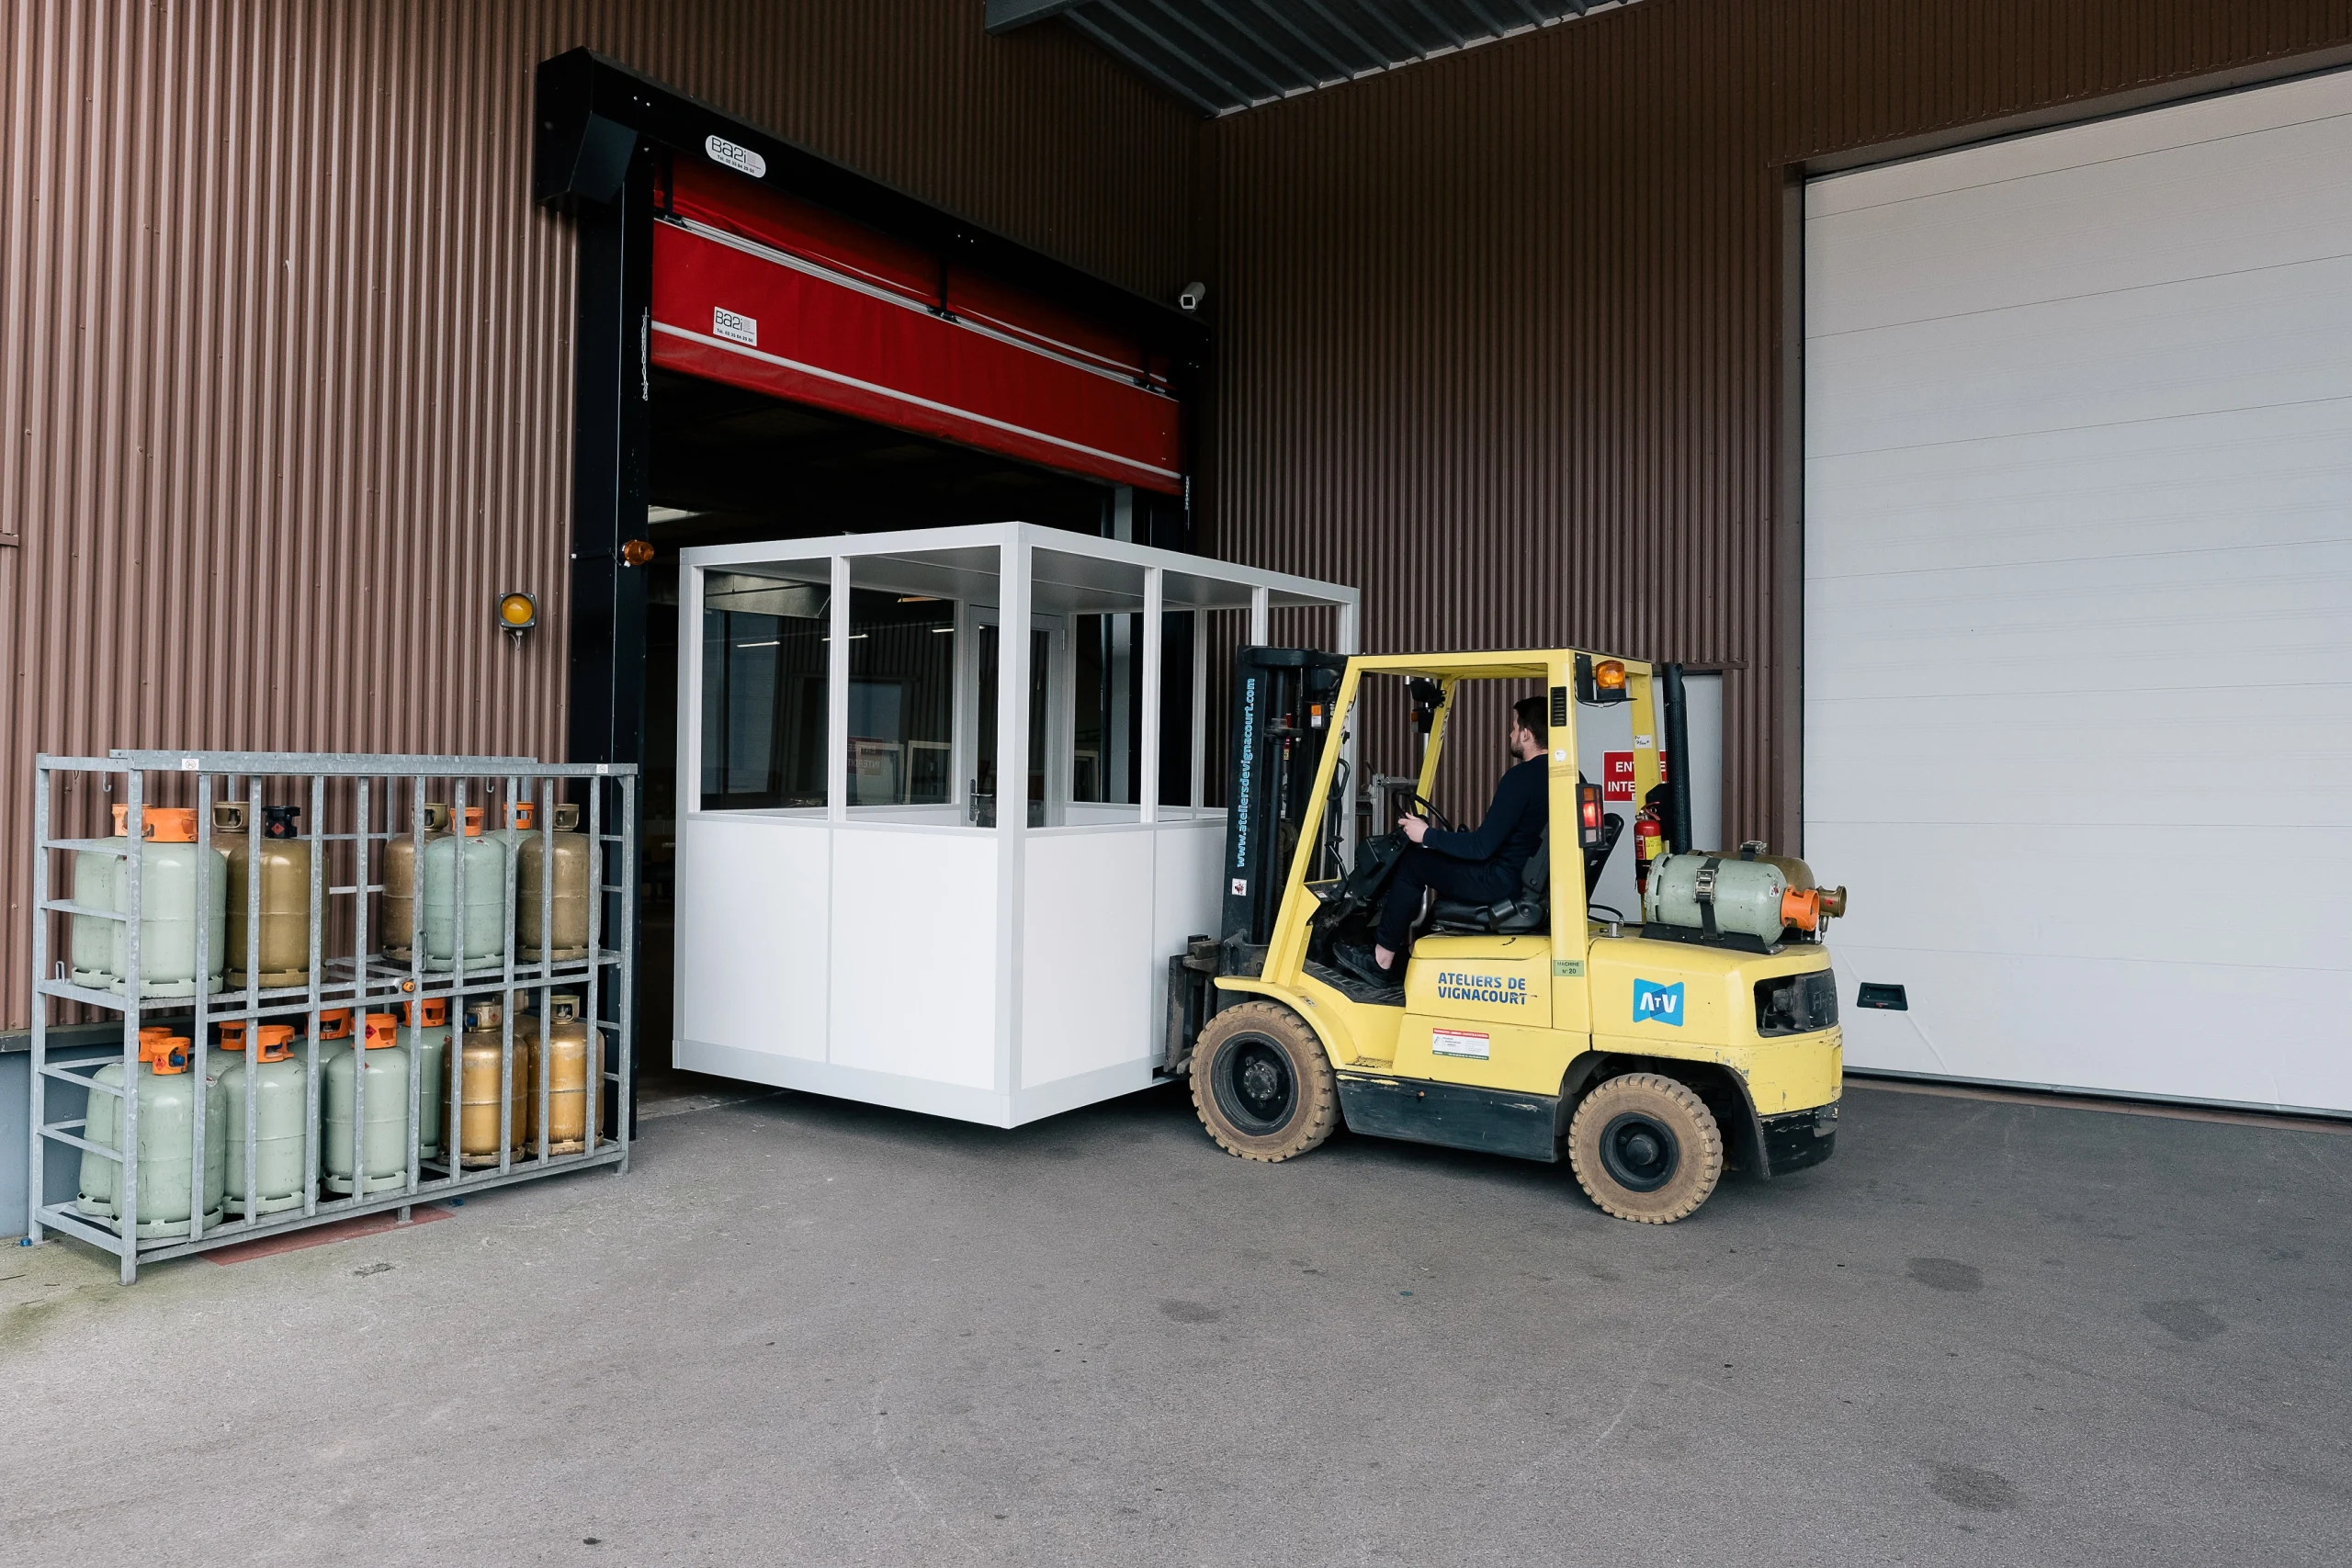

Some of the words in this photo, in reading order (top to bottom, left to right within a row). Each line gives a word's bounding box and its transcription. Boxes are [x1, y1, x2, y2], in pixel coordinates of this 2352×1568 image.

[1236, 678, 1256, 868] www.ateliersdevignacourt.com
[1438, 972, 1502, 988] ATELIERS
[1508, 977, 1526, 990] DE
[1438, 986, 1527, 1005] VIGNACOURT
